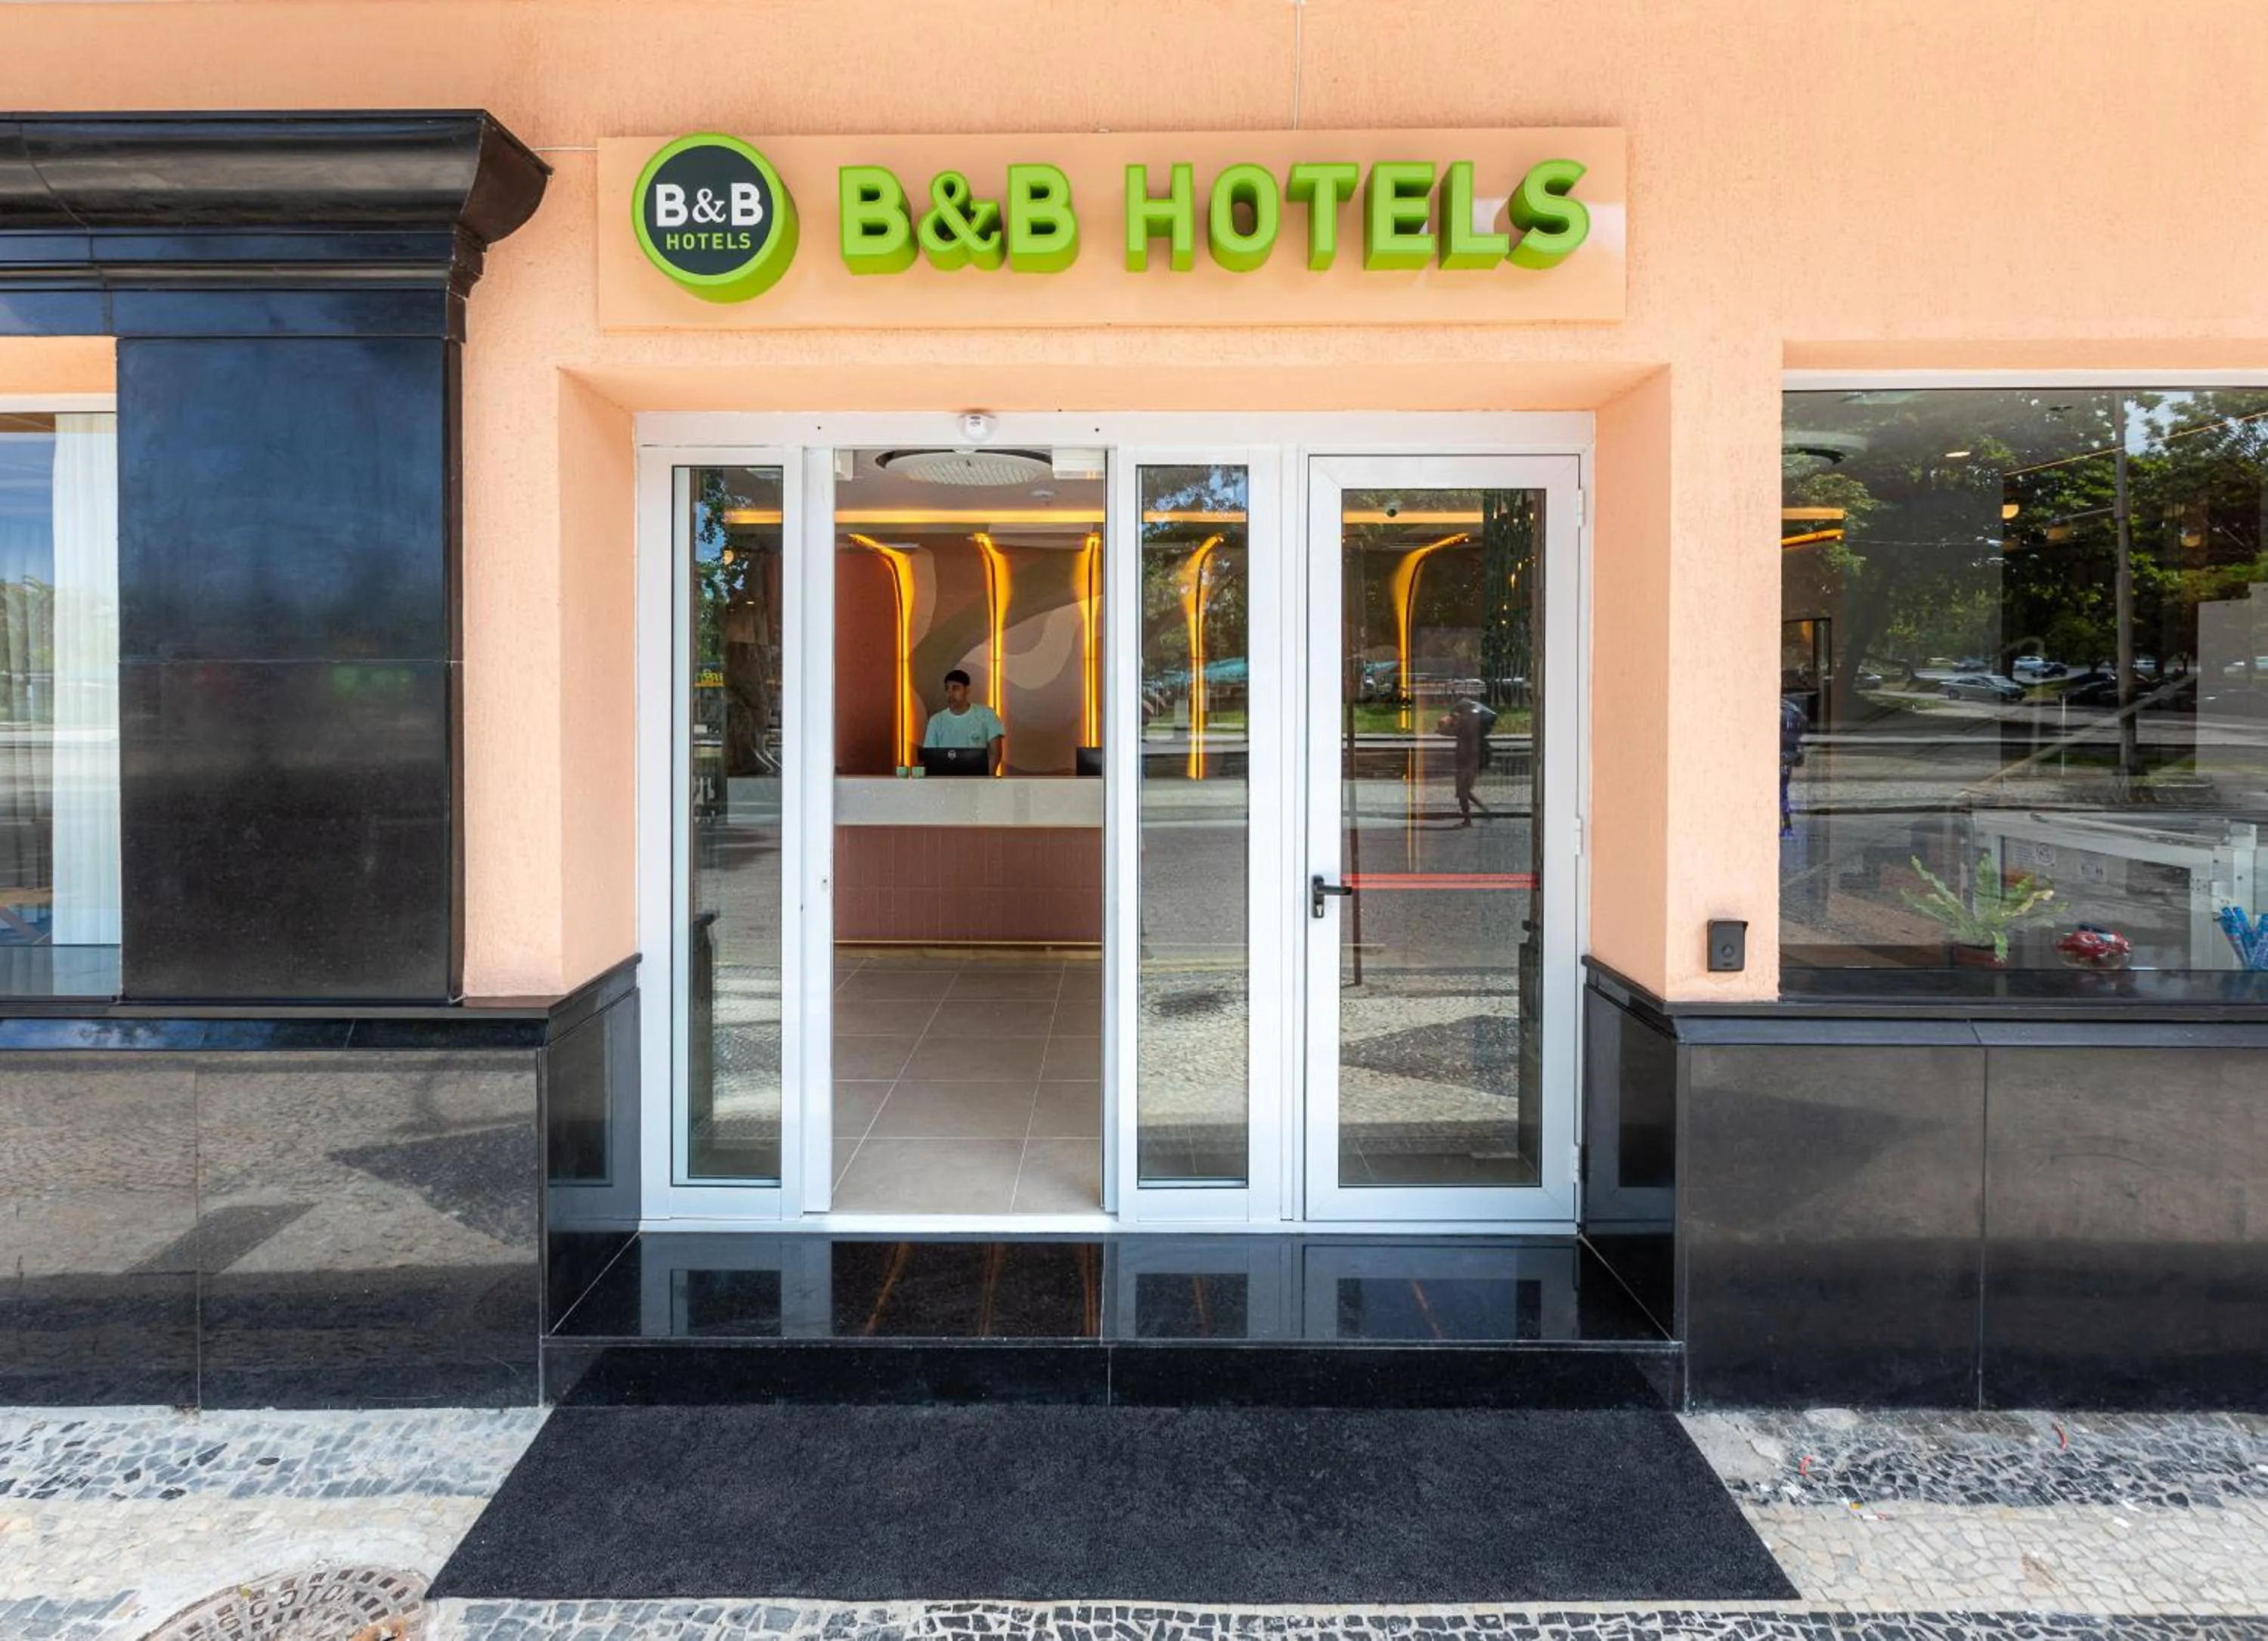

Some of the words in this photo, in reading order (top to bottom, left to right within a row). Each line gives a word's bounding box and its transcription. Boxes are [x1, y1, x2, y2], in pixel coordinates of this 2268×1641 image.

[655, 182, 764, 227] B&B
[839, 164, 1079, 275] B&B
[1125, 159, 1590, 272] HOTELS
[665, 232, 751, 250] HOTELS
